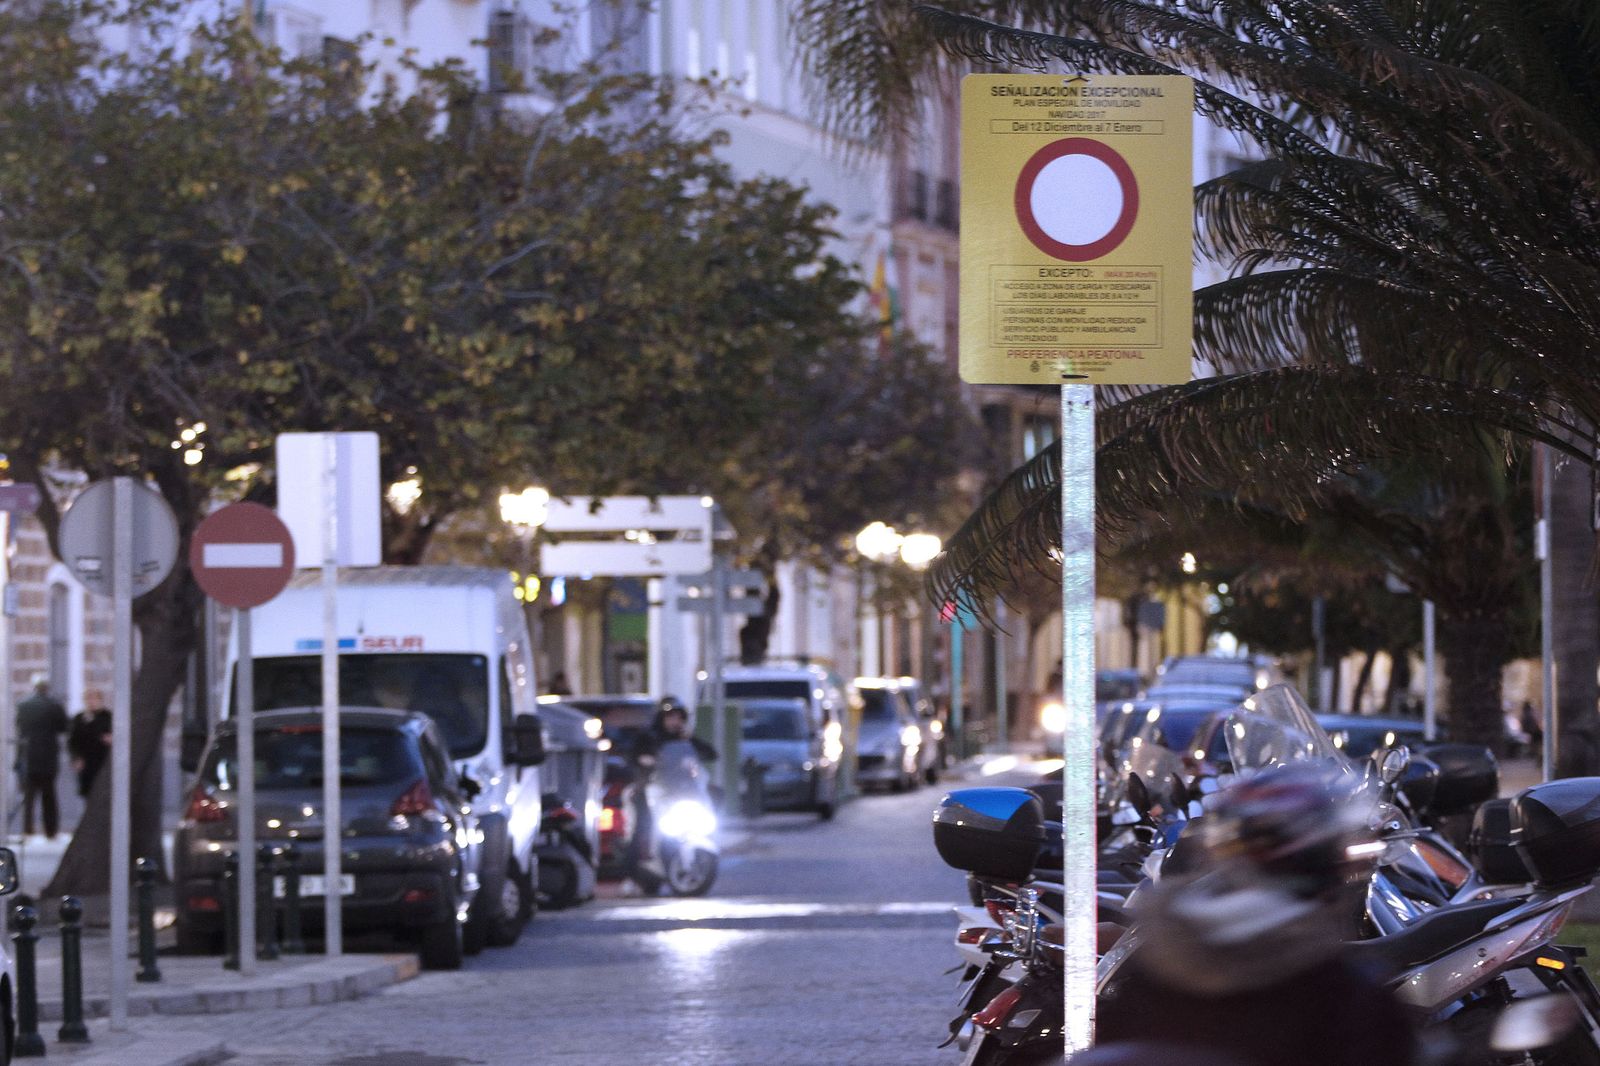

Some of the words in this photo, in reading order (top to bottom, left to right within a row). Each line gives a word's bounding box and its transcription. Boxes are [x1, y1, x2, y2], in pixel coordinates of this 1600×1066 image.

[1081, 87, 1164, 98] EXCEPCIONAL
[1013, 99, 1036, 107] PLAN
[1038, 99, 1079, 107] ESPECIAL
[1081, 99, 1092, 107] DE
[1094, 99, 1141, 108] MOVILIDAD
[1048, 111, 1084, 119] NAVIDAD
[1087, 111, 1106, 119] 2017
[1012, 122, 1028, 132] Del
[1030, 122, 1042, 132] 12
[1043, 122, 1093, 132] Diciembre
[1095, 122, 1103, 132] al
[1105, 122, 1111, 132] 7
[1113, 122, 1141, 132] Enero
[1039, 268, 1094, 278] EXCEPTO:
[1007, 350, 1085, 359] PREFERENCIA
[1086, 350, 1145, 360] PEATONAL
